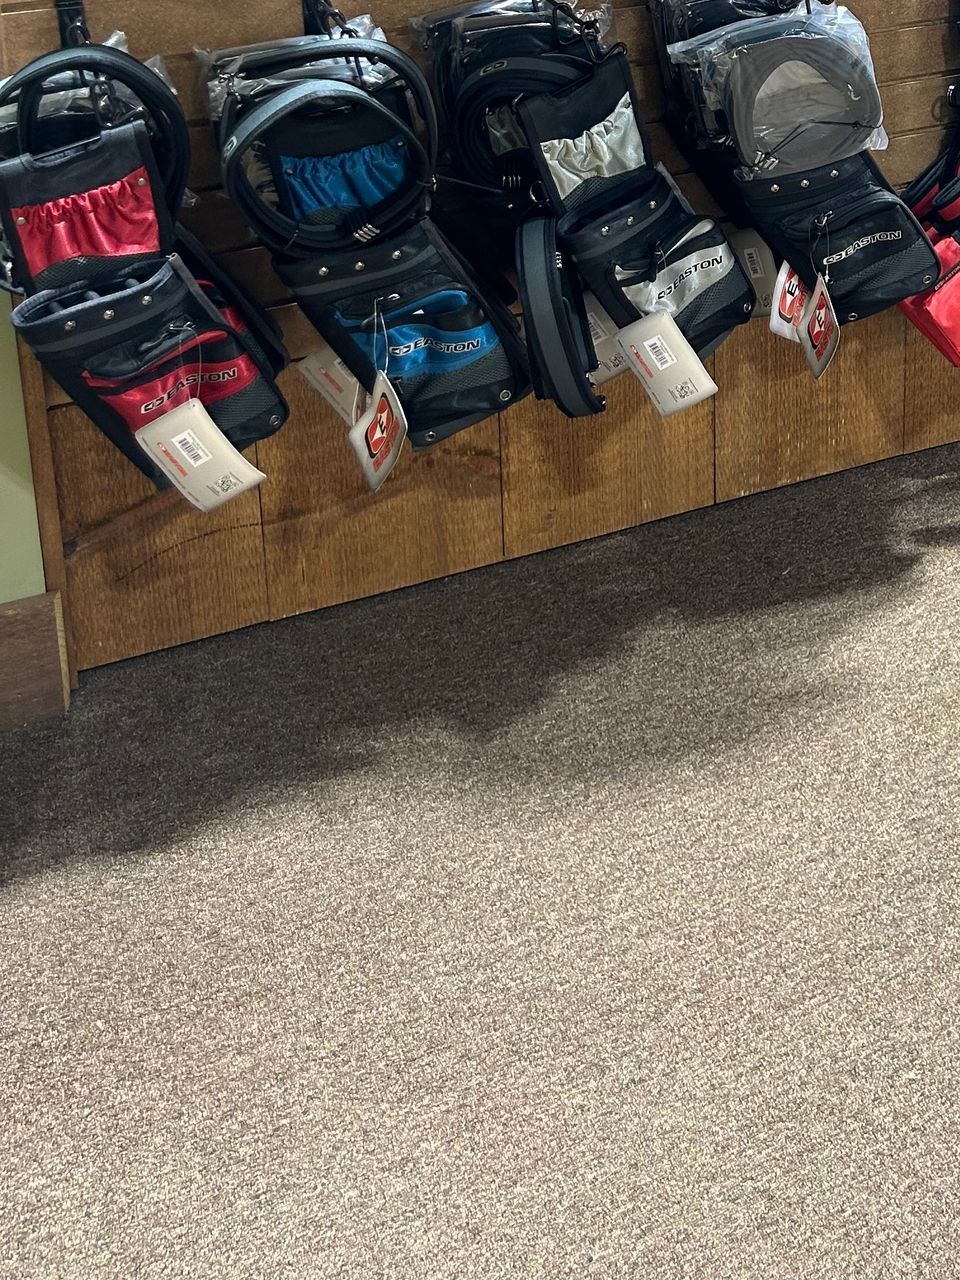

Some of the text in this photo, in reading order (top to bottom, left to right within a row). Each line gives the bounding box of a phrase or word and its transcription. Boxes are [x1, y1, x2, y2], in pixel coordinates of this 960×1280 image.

[844, 230, 902, 257] EASTON
[674, 255, 723, 290] EASTON
[414, 337, 482, 354] EASTON
[167, 367, 238, 401] EASTON
